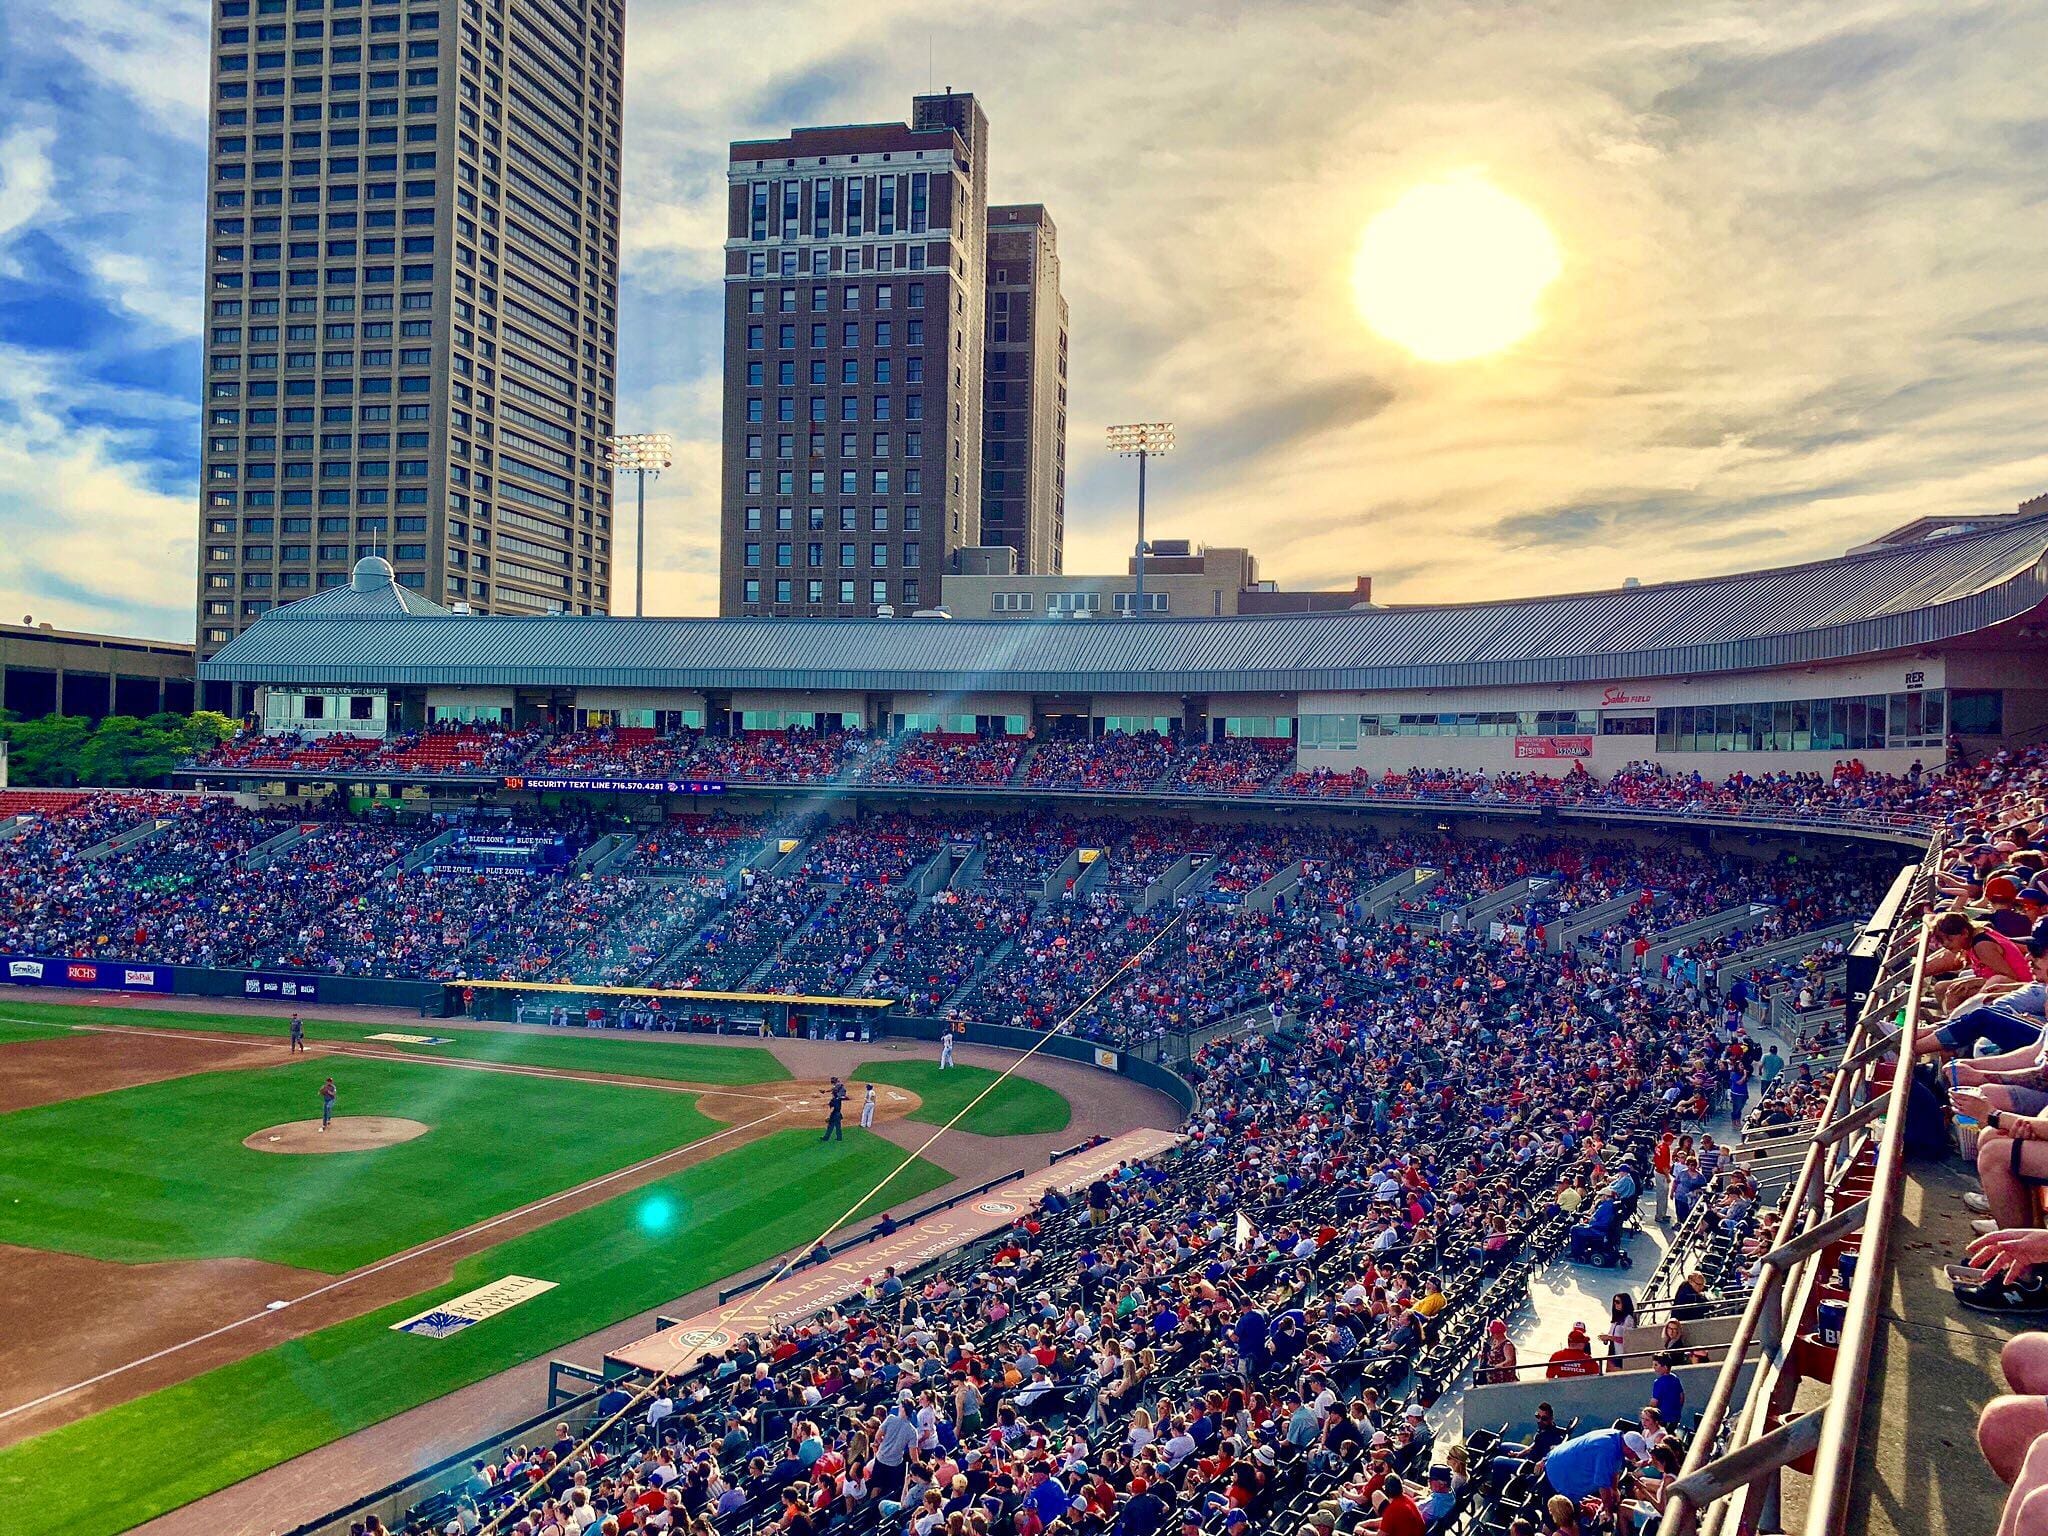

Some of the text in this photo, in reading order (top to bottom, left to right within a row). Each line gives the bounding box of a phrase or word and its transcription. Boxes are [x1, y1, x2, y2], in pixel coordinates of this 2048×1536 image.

[1905, 671, 1925, 684] RER
[1630, 695, 1652, 703] FIELD
[527, 780, 567, 789] SECURITY
[568, 781, 590, 789] TEXT
[591, 782, 611, 790] LINE
[611, 782, 664, 791] 716.570.4281
[468, 835, 504, 844] BLUE ZONE
[452, 866, 472, 874] ZONE
[485, 867, 525, 876] BLUE ZONE
[68, 966, 97, 979] RICH'S
[718, 1273, 838, 1330] SAHLEN
[829, 1233, 929, 1275] PACKING
[451, 1278, 538, 1314] ROSWELL
[469, 1296, 520, 1318] PARK
[776, 1290, 836, 1321] PACKERS
